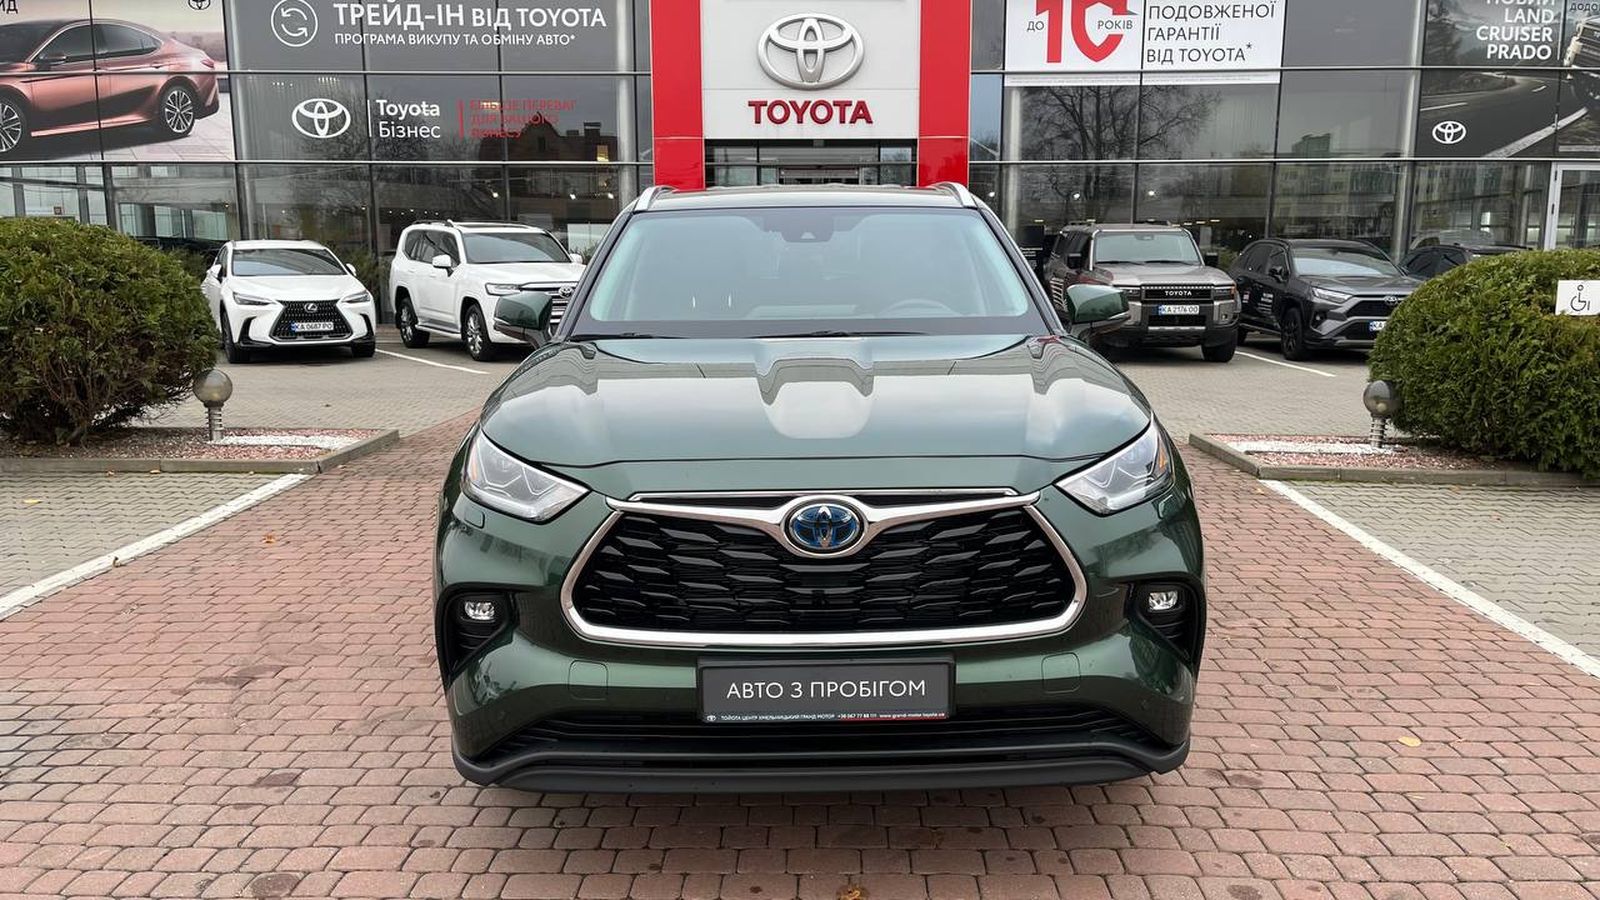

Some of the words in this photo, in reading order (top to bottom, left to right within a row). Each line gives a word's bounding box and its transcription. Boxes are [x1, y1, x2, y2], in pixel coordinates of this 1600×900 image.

[333, 0, 464, 31] ТРЕЙД-ІН
[472, 8, 512, 31] ВІД
[516, 8, 607, 27] TOYOTA
[1149, 0, 1277, 21] ПОДОВЖЕНОЇ
[1504, 8, 1555, 24] LAND
[1569, 3, 1600, 12] ДОДО
[1026, 21, 1045, 32] ДО
[1097, 20, 1133, 30] РОКІВ
[1147, 23, 1222, 41] ГАРАНТІЇ
[1476, 25, 1553, 42] CRUISER
[334, 33, 406, 45] ПРОГРАМА
[408, 33, 460, 45] ВИКУПУ
[463, 33, 479, 45] ТА
[481, 33, 533, 46] ОБМІНУ
[1146, 48, 1174, 65] ВІД
[1486, 44, 1552, 60] PRADO
[376, 99, 441, 121] Toyota
[747, 99, 874, 125] TOYOTA
[379, 121, 441, 138] Бізнес
[726, 681, 784, 699] АВТО
[811, 679, 926, 698] ПРОБІГОМ
